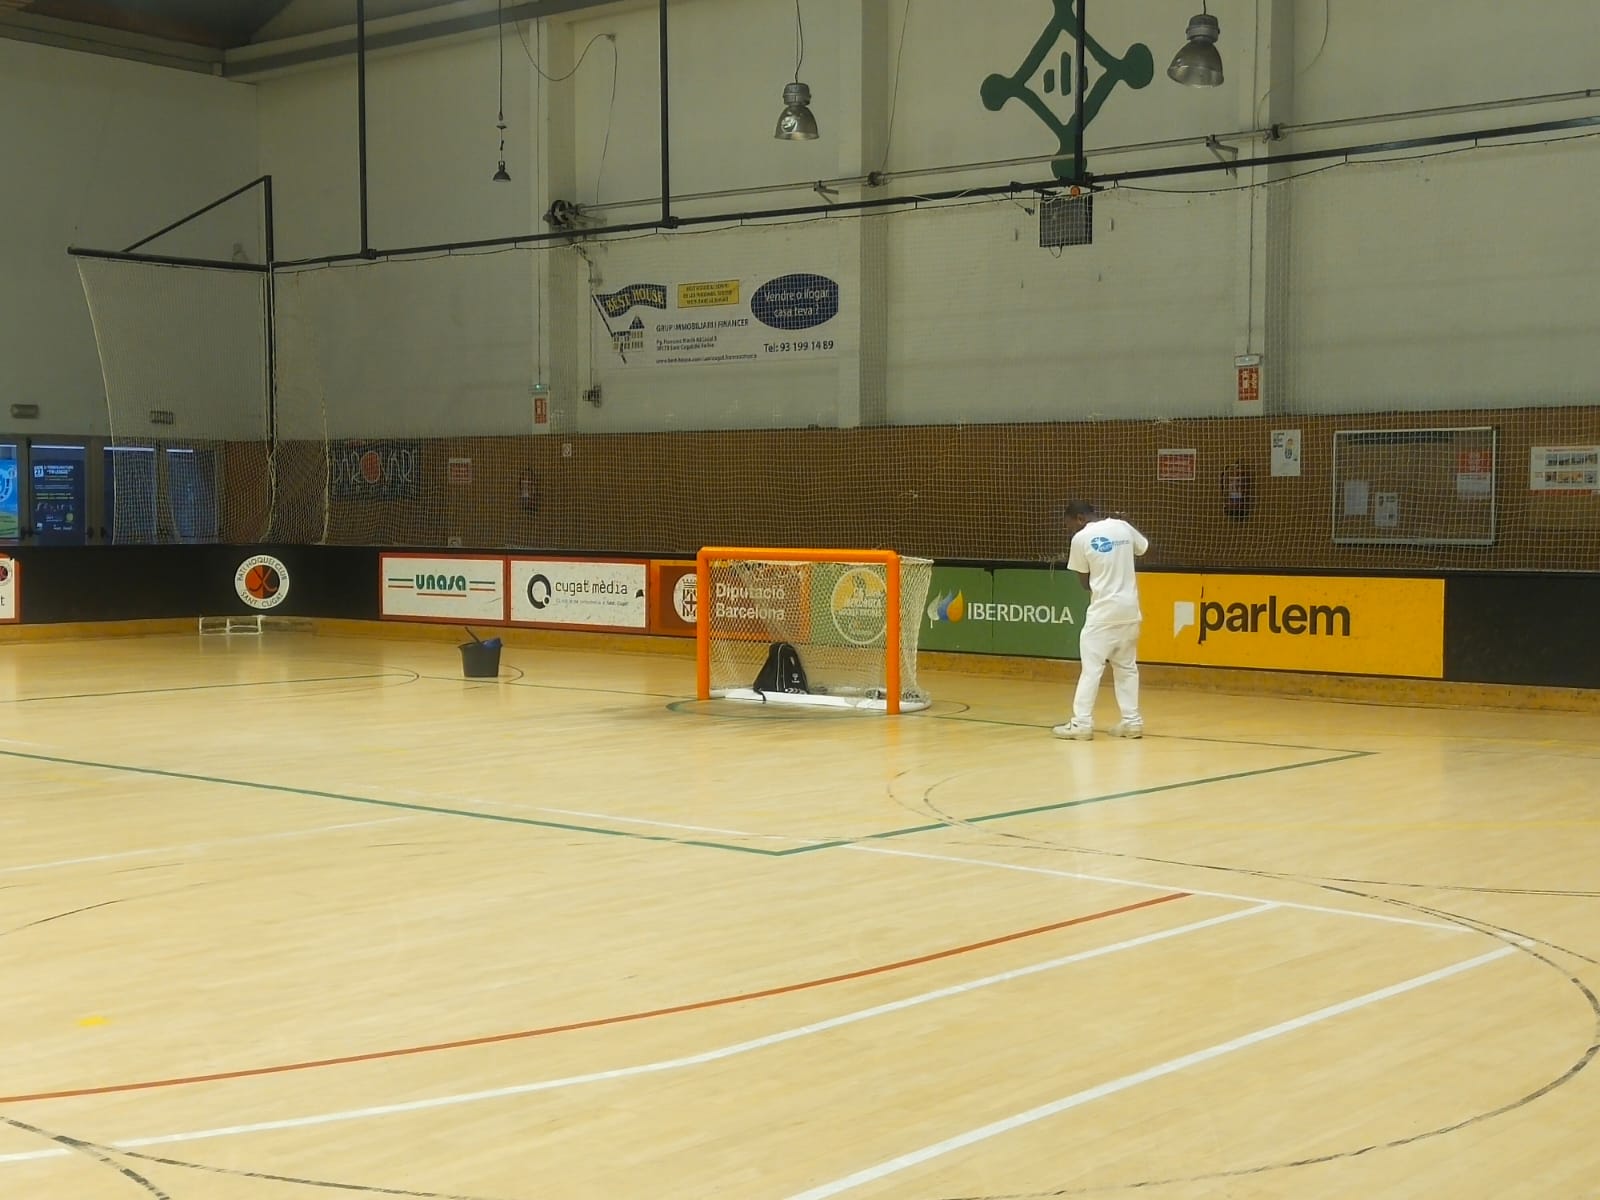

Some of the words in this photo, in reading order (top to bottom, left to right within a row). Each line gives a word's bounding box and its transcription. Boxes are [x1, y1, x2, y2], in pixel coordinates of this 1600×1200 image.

[605, 295, 630, 312] BEST
[632, 288, 665, 305] HOUSE
[764, 290, 794, 301] Vendre
[773, 307, 793, 317] casa
[763, 343, 778, 353] Tel:
[779, 342, 791, 352] 93
[793, 341, 808, 351] 199
[810, 341, 821, 351] 14
[822, 340, 834, 350] 89
[555, 579, 589, 597] cugat
[592, 580, 628, 595] mèdia
[715, 582, 785, 601] Diputació
[241, 590, 257, 606] SANT
[261, 592, 283, 608] CUGAT
[715, 602, 785, 621] Barcelona
[967, 601, 1074, 625] IBERDROLA
[1199, 595, 1351, 638] parlem
